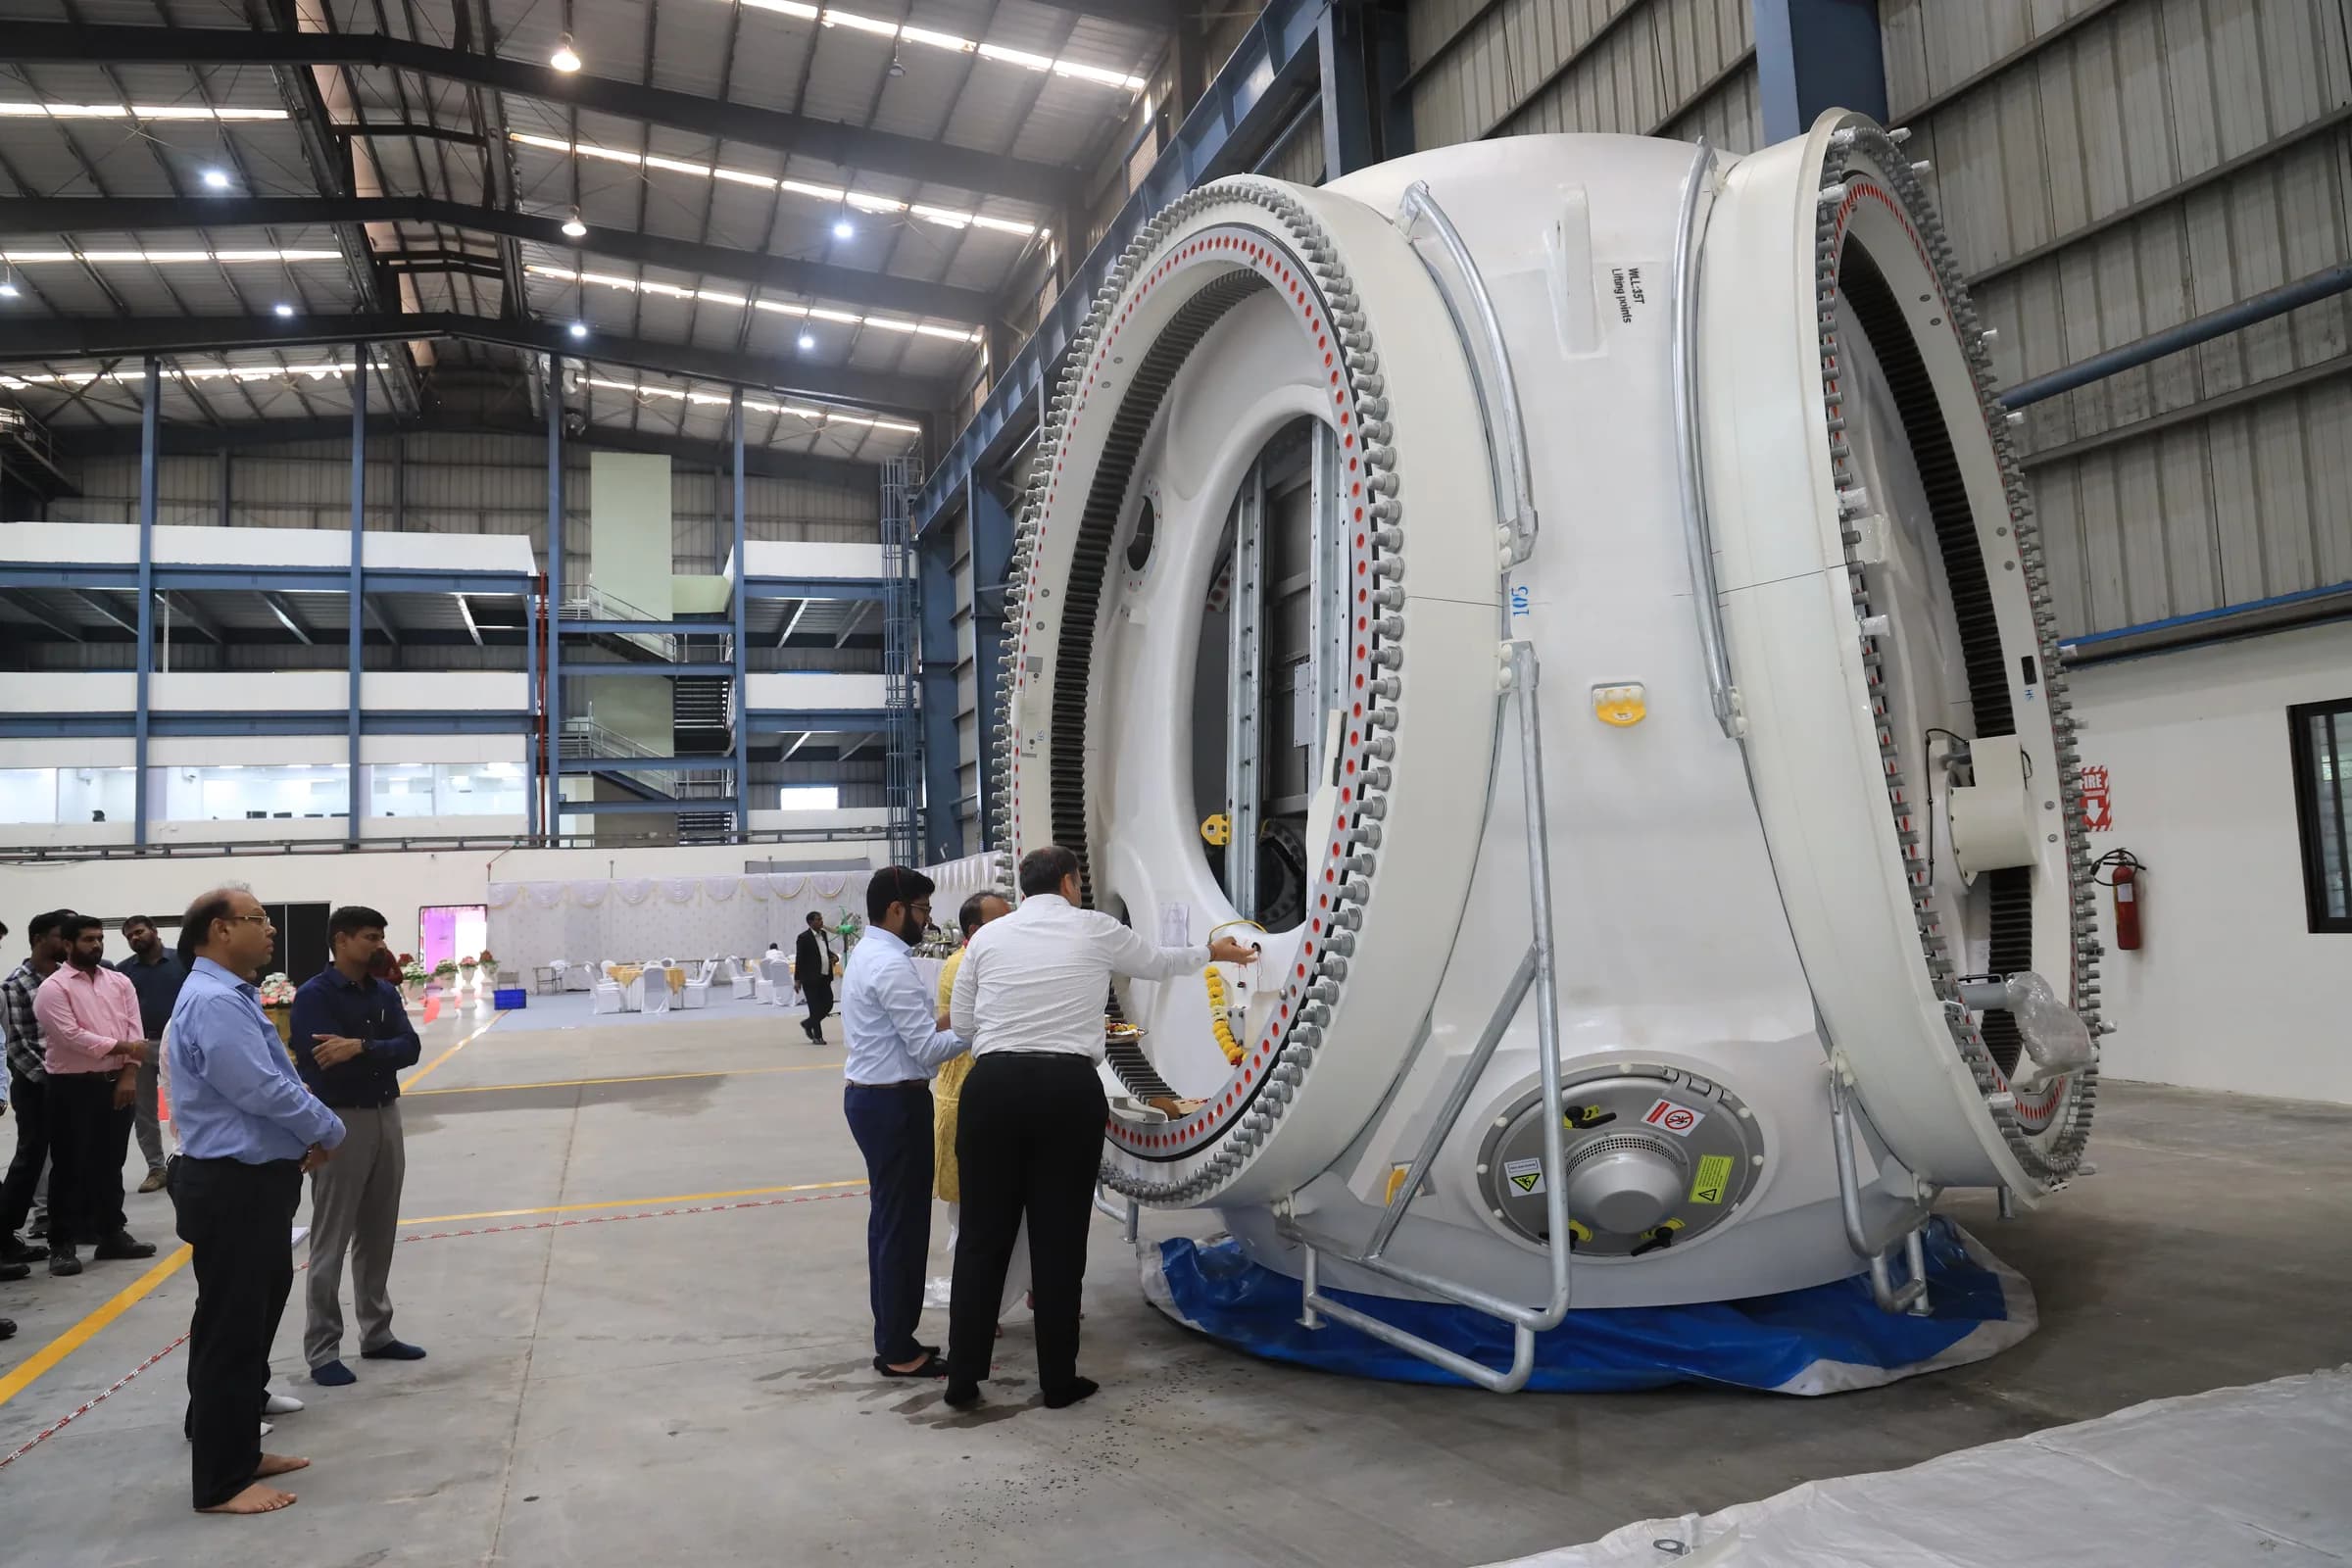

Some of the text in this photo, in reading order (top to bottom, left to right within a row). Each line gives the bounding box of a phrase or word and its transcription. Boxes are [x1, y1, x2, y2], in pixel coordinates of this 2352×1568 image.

[1611, 268, 1633, 323] Lifting points
[1511, 586, 1530, 616] 105
